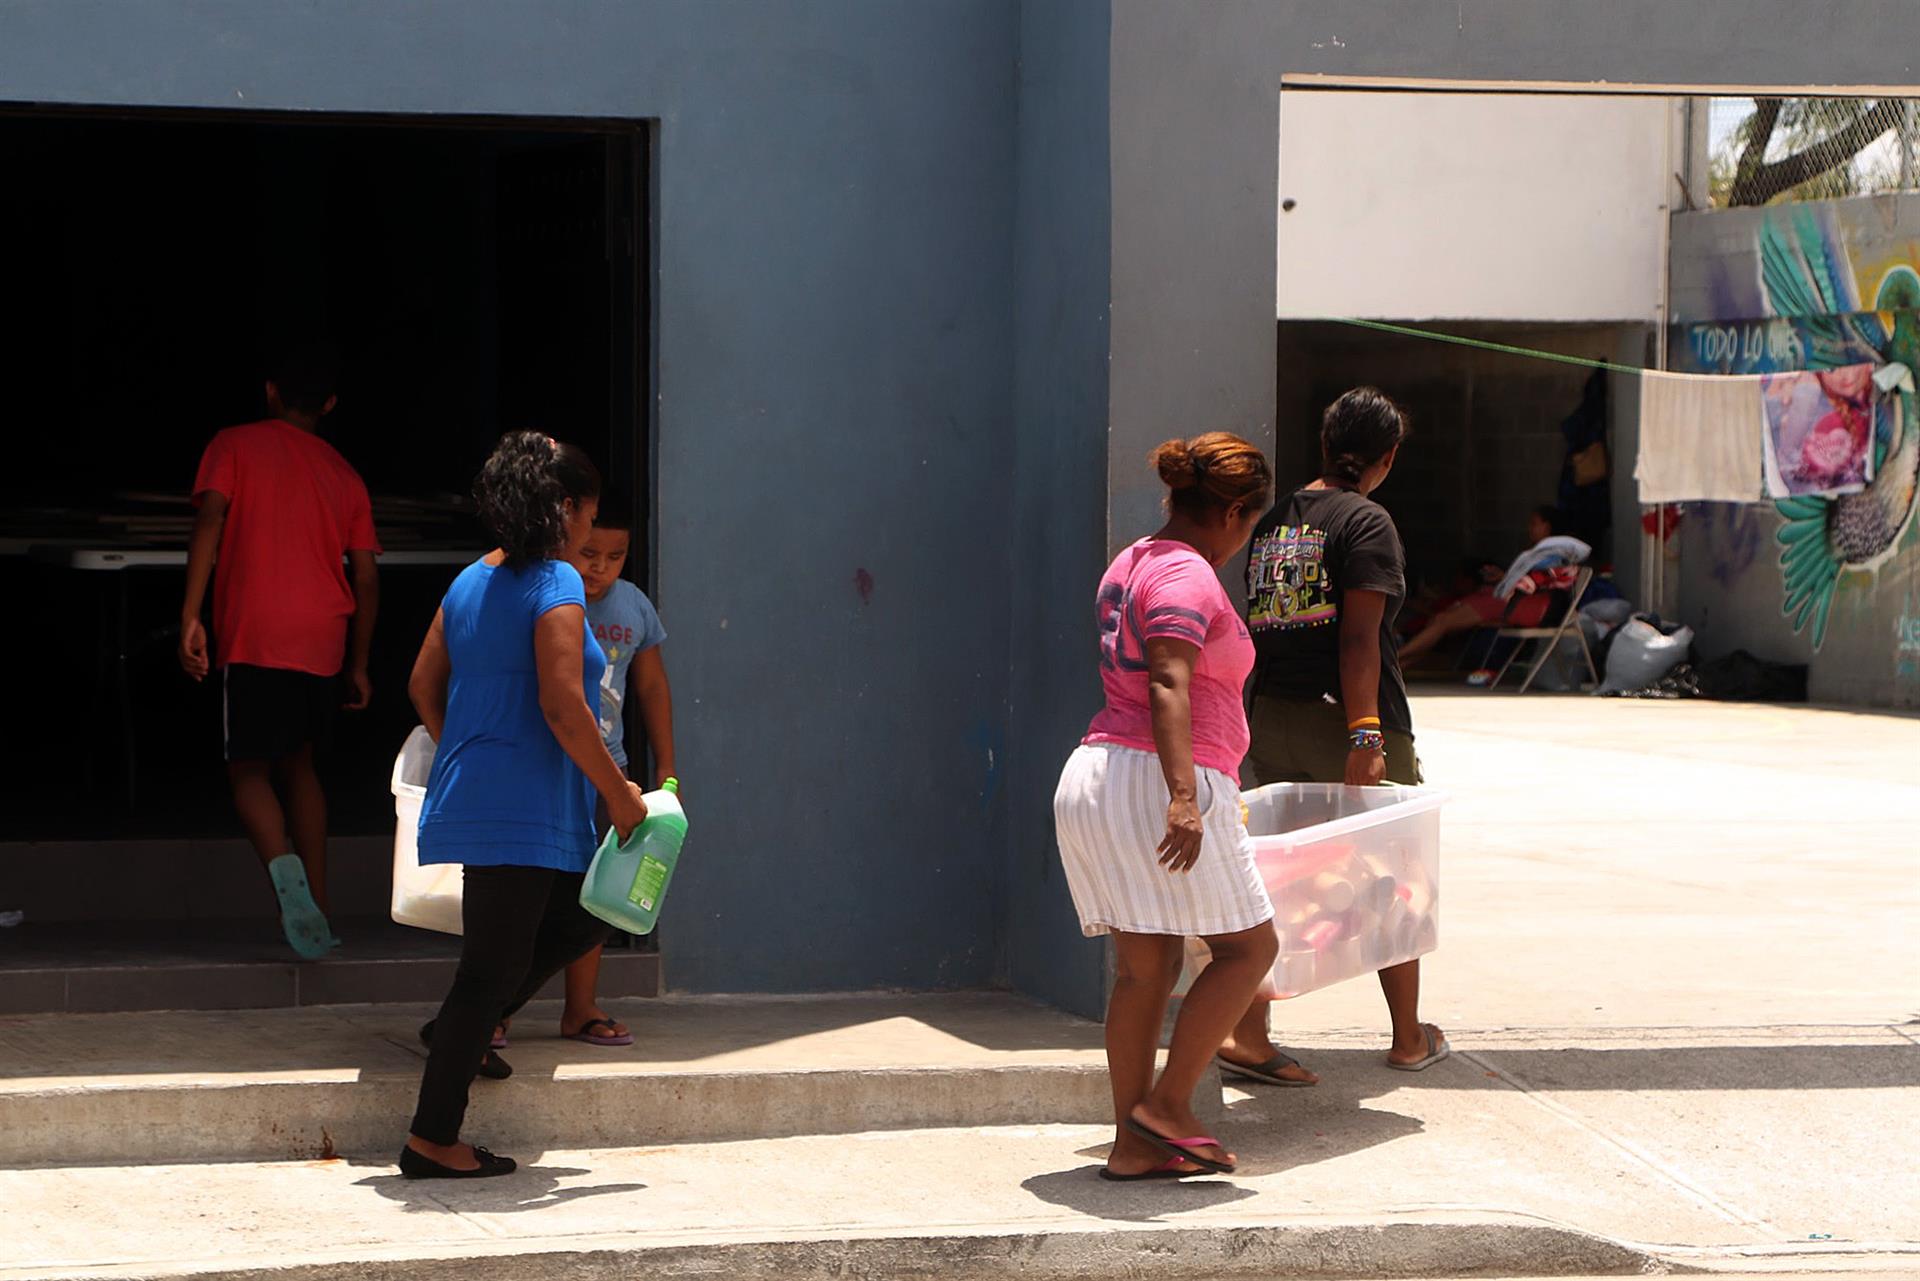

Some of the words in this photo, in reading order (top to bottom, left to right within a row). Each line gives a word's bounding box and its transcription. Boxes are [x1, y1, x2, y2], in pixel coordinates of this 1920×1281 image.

[1693, 325, 1738, 362] TODO
[1743, 324, 1763, 362] LO
[590, 623, 633, 646] AGE
